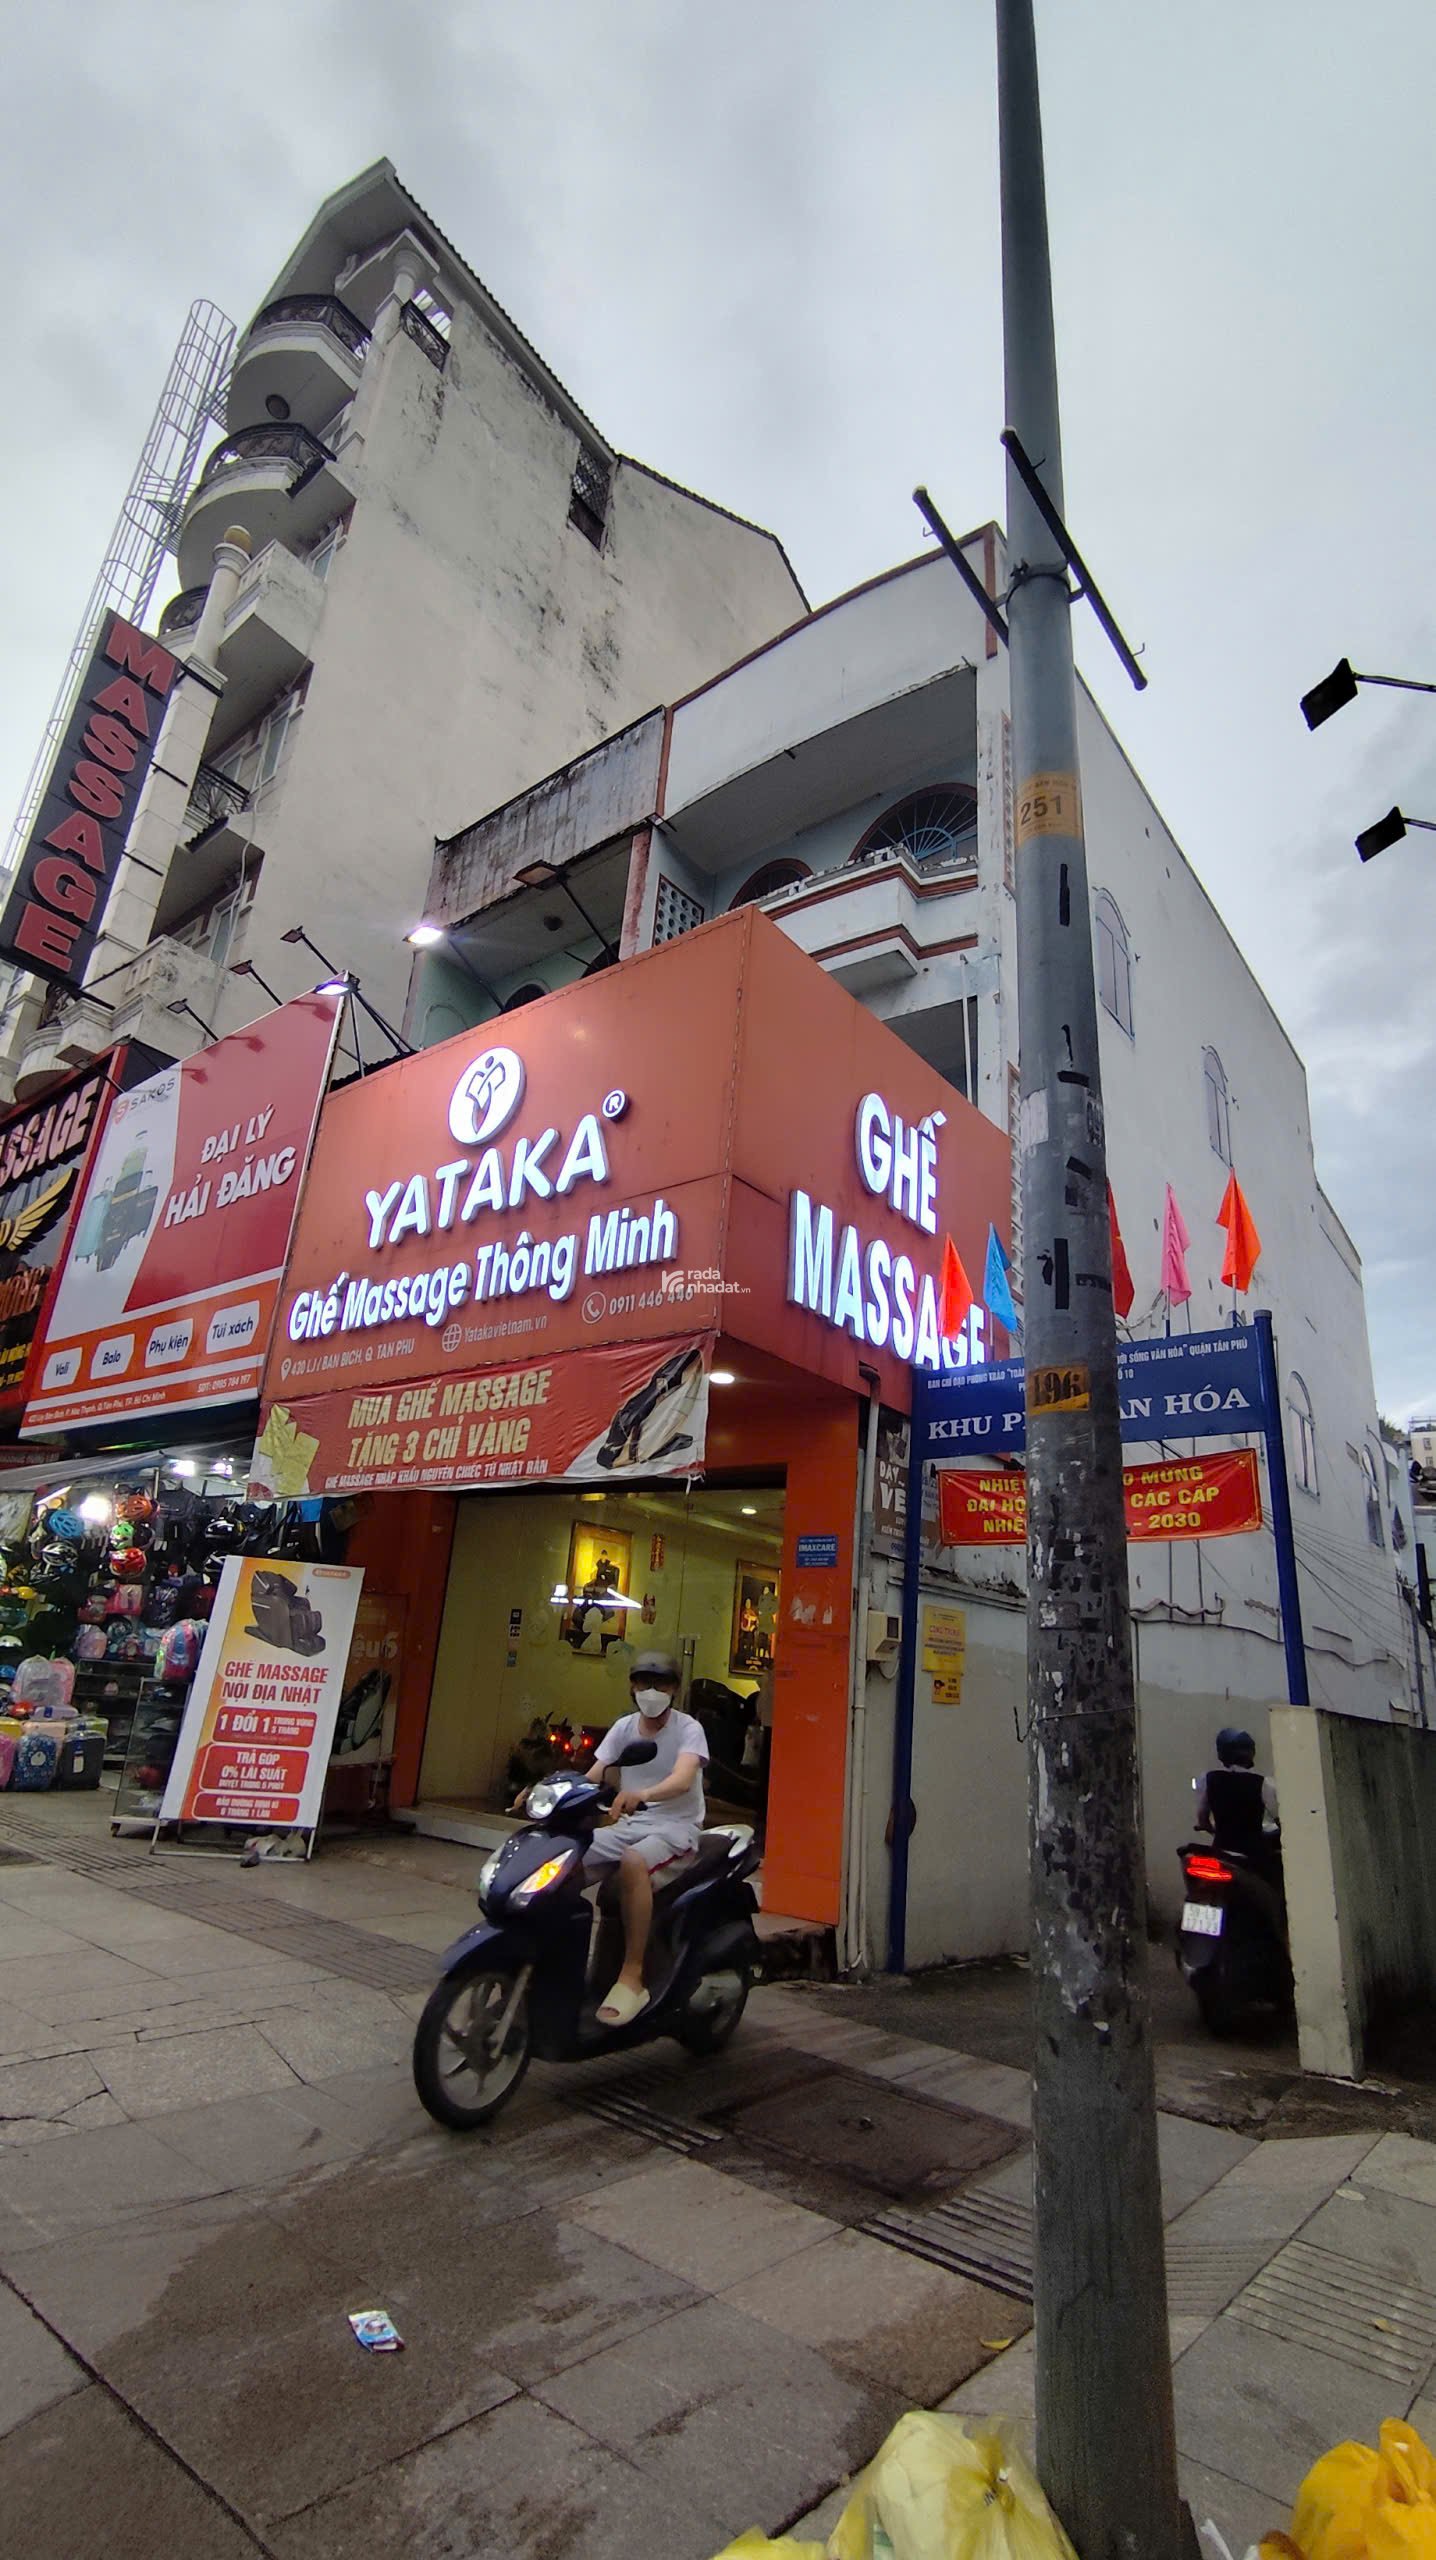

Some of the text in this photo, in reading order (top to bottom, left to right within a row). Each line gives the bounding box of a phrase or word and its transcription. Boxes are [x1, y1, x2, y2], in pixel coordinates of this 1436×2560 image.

[14, 619, 177, 973] MASSAGE
[1020, 795, 1061, 825] 251
[130, 1078, 175, 1110] SAKOS
[0, 1076, 100, 1187] SSAGE
[201, 1103, 275, 1163] ĐẠI LÝ
[856, 1091, 947, 1236] GHẾ
[164, 1146, 296, 1228] HẢI ĐĂNG
[364, 1113, 609, 1250] YATAKA
[288, 1198, 678, 1342] Ghế Massage Thông Minh
[609, 1294, 635, 1315] 0911
[638, 1289, 663, 1308] 446
[212, 1316, 253, 1340] Túi xách
[149, 1333, 188, 1355] Phụ kiện
[377, 1342, 394, 1360] TAN
[396, 1338, 415, 1355] PHU
[1129, 1348, 1149, 1363] SỐNG
[1151, 1346, 1166, 1360] VĂN
[1189, 1341, 1211, 1357] QUẬN
[1213, 1339, 1229, 1352] TÂN
[102, 1350, 121, 1366] Balo
[1124, 1368, 1134, 1379] 10
[348, 1370, 552, 1428] MUA GHẾ MASSAGE
[1164, 1384, 1250, 1415] HÓA
[402, 1431, 420, 1463] 3
[422, 1415, 464, 1461] CHỈ
[466, 1416, 531, 1457] VÀNG
[928, 1415, 992, 1439] KHU
[339, 1472, 374, 1488] MASSAGE
[497, 1459, 523, 1479] NHẬT
[526, 1455, 548, 1475] BẢN
[1142, 1465, 1204, 1484] MỪNG
[980, 1476, 1026, 1494] NHIỆ
[1130, 1483, 1220, 1508] CÁC CẤP
[967, 1495, 1026, 1515] ĐẠI HỘ
[1148, 1512, 1201, 1529] 2030
[225, 1658, 329, 1684] GHẾ MASSAGE
[222, 1680, 322, 1707] NỘI ĐỊA NHẬT
[219, 1709, 271, 1733] 1 ĐỔI 1
[236, 1749, 280, 1766] TRẢ GÓP
[221, 1765, 238, 1778] 0%
[259, 1765, 288, 1781] SUẤT
